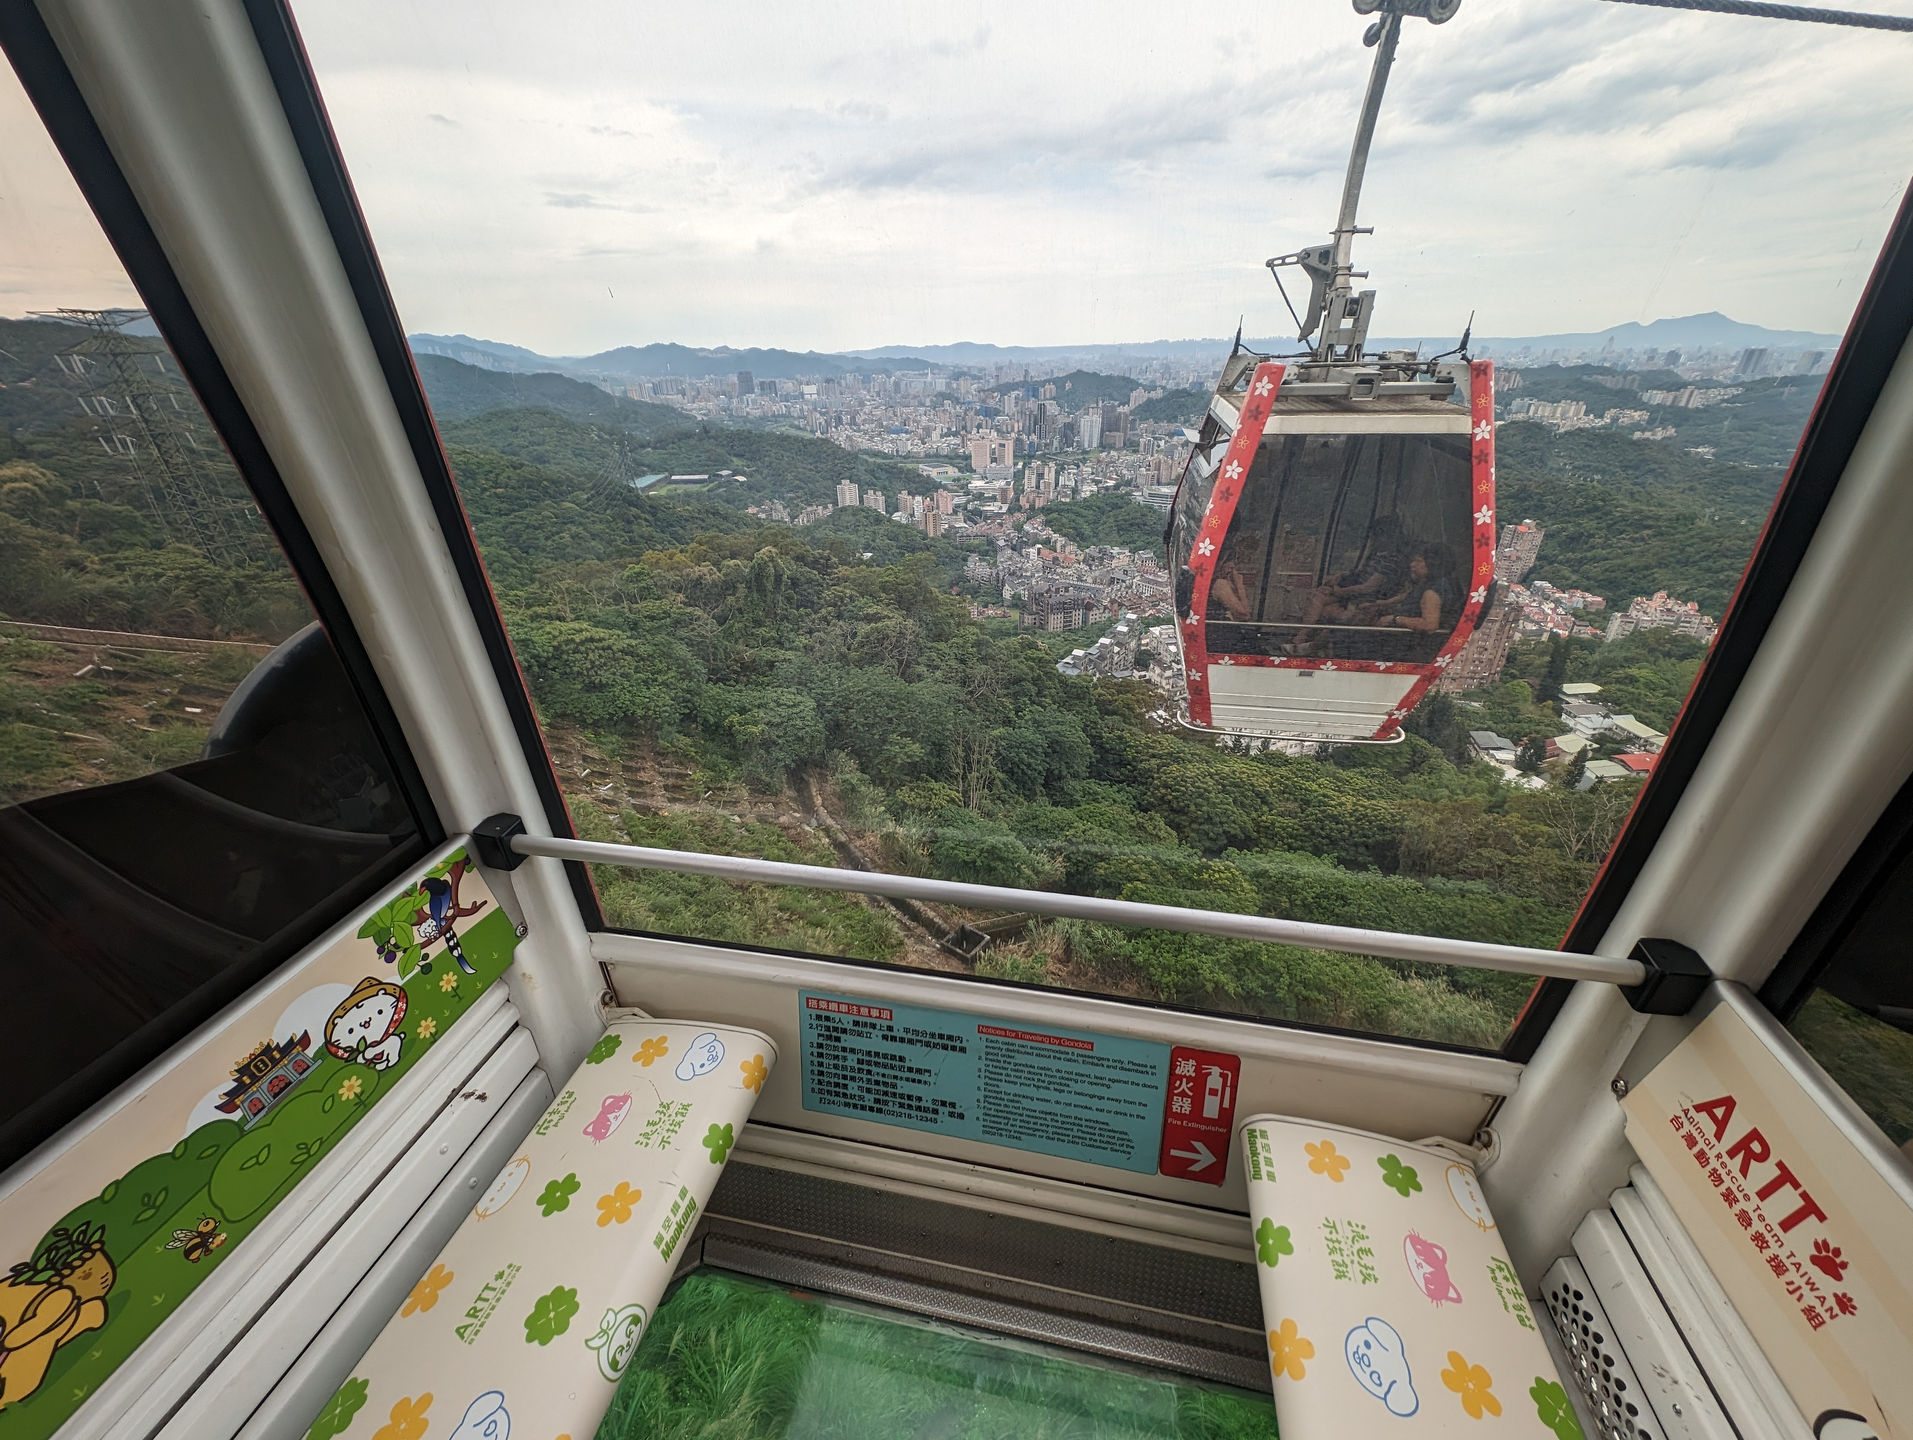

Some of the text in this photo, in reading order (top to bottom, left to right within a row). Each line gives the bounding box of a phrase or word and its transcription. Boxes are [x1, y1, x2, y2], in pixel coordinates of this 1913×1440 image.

[979, 1026, 1005, 1035] Notices
[1017, 1032, 1050, 1043] Traveling
[1061, 1038, 1092, 1048] Gondola
[1171, 1057, 1197, 1115] 滅火器
[1167, 1117, 1227, 1134] Fire Extinguisher
[1246, 1128, 1263, 1181] Maokong
[1692, 1095, 1828, 1234] ARTT
[661, 1195, 697, 1264] Maokong
[1669, 1114, 1827, 1332] 台灣動物緊急救援小組
[1680, 1106, 1840, 1321] Animal Rescue Team TAIWAN
[454, 1282, 498, 1341] ARTT
